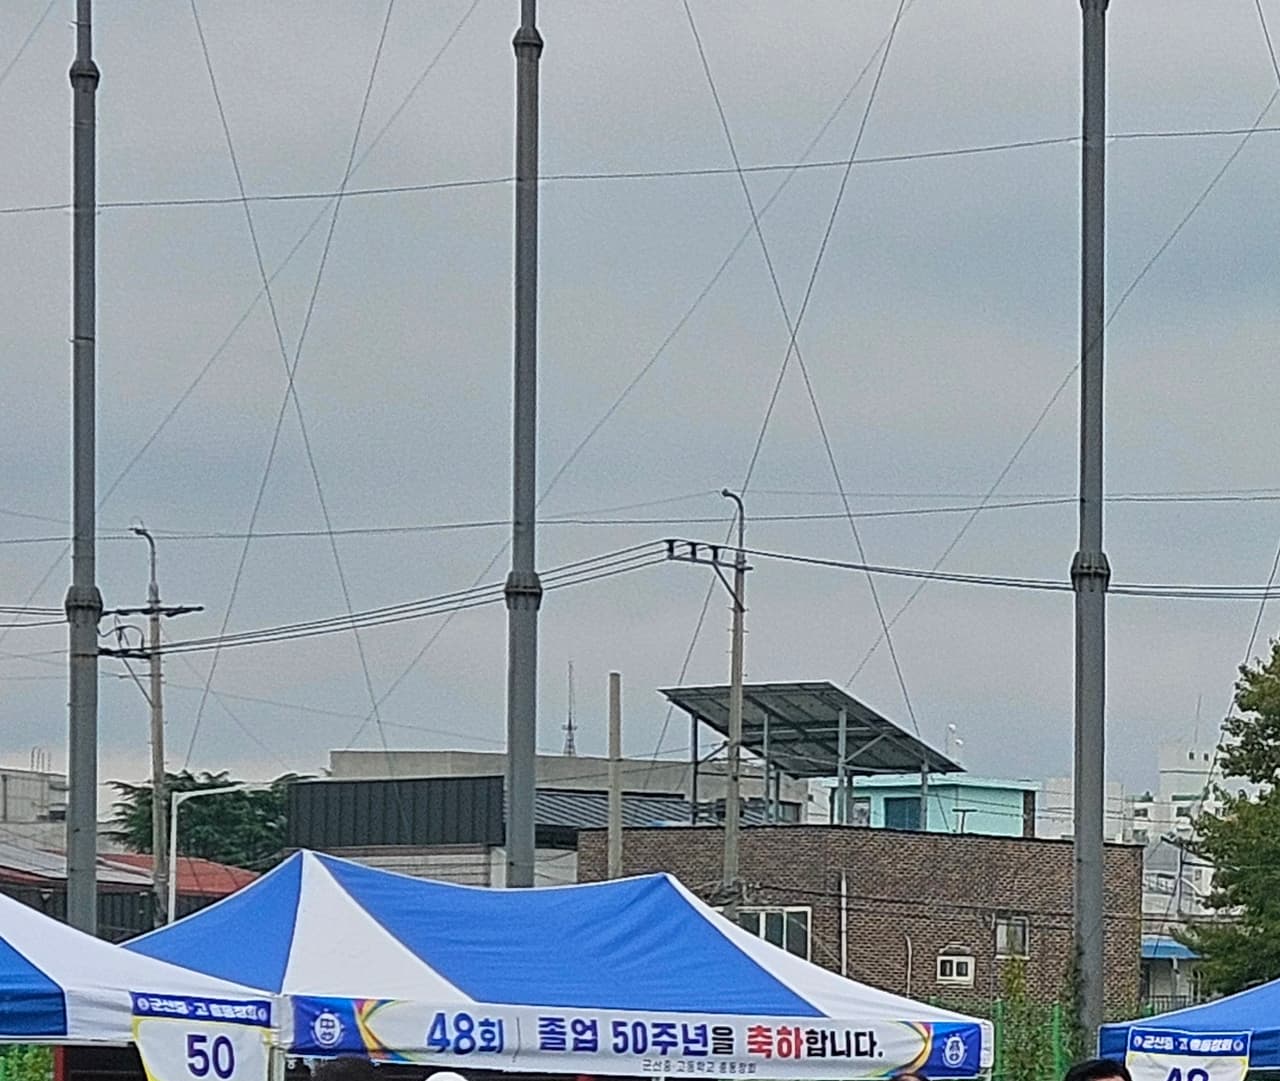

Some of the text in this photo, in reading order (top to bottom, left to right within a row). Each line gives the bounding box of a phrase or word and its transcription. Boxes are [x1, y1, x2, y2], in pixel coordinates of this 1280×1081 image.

[187, 1034, 235, 1079] 50
[427, 1013, 883, 1059] 48회 졸업 50주년을 축하합니다.
